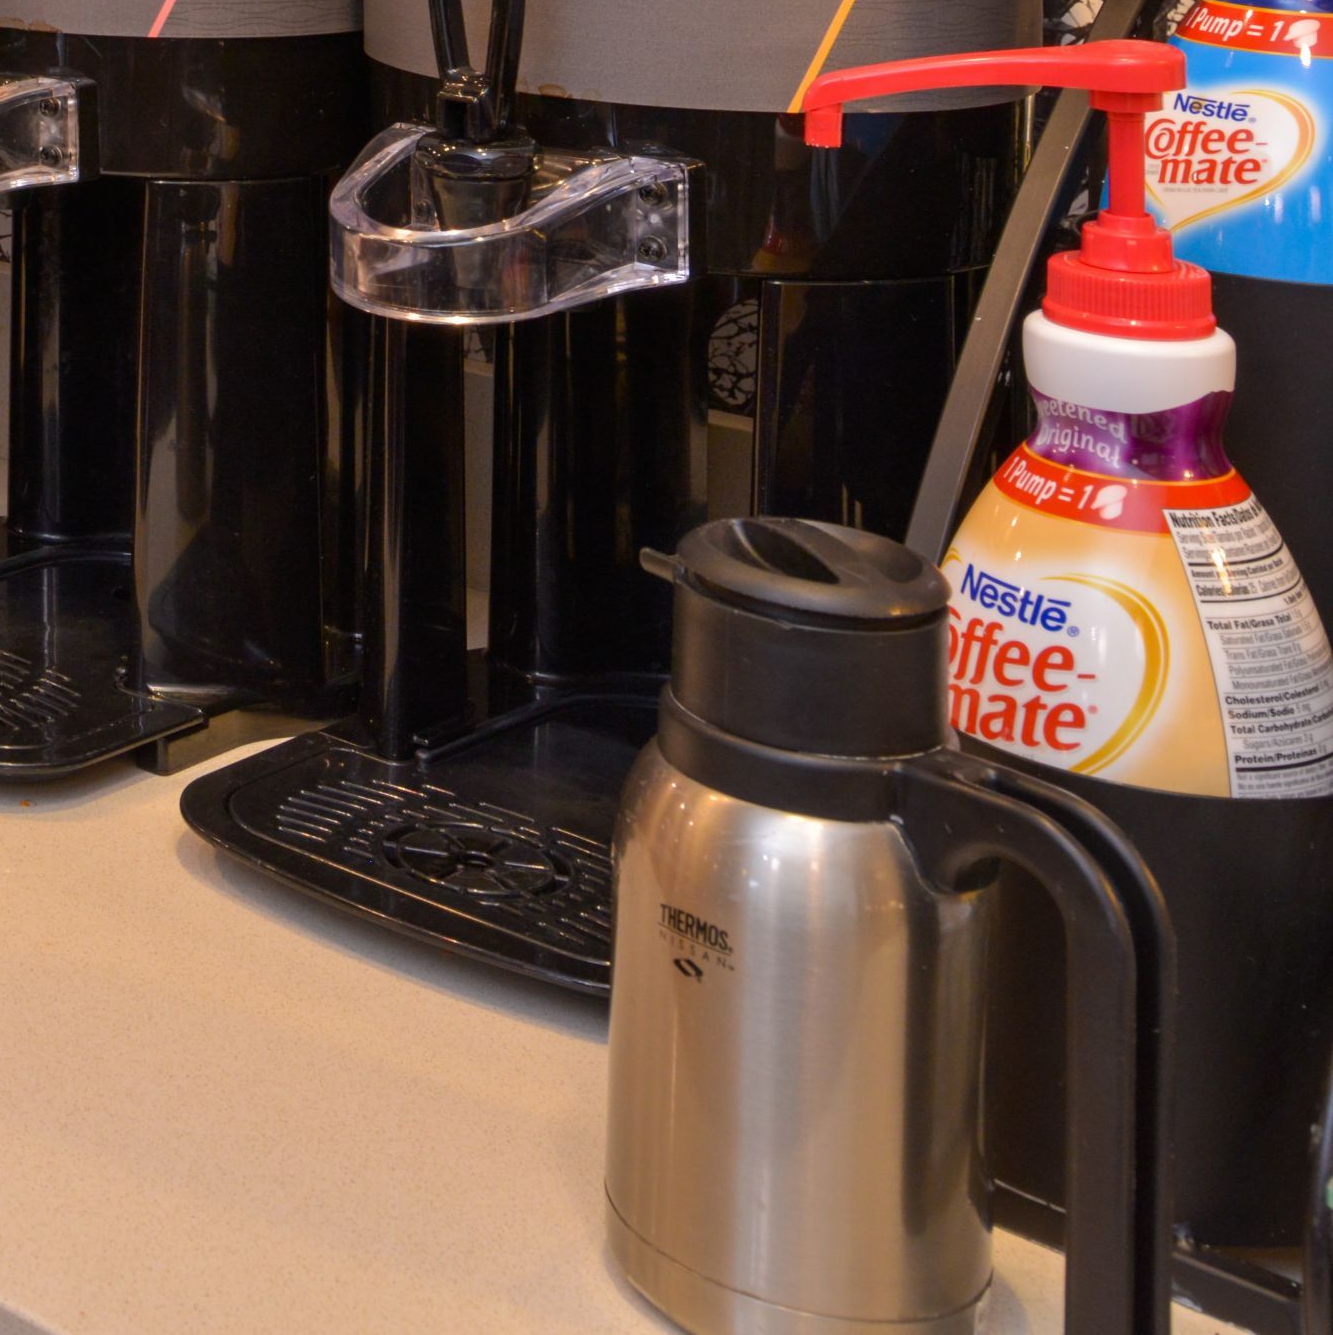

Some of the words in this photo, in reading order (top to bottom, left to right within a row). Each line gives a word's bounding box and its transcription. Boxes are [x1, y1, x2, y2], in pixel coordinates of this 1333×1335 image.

[1191, 7, 1244, 42] Pump
[1270, 20, 1285, 42] 1
[1158, 155, 1262, 185] mate
[1042, 399, 1127, 444] eetened
[1036, 422, 1120, 469] Original
[1008, 460, 1057, 505] Pump
[1077, 485, 1094, 510] 1
[1169, 511, 1215, 529] Nutrition
[1206, 620, 1232, 631] Total
[1234, 617, 1275, 631] Fat/Grasa
[1275, 611, 1292, 624] Total
[1225, 684, 1319, 705] Cholesterol/Colesterol
[1228, 706, 1295, 720] Sodium/Sodio
[1230, 725, 1256, 735] Total
[660, 903, 729, 951] THERMOS
